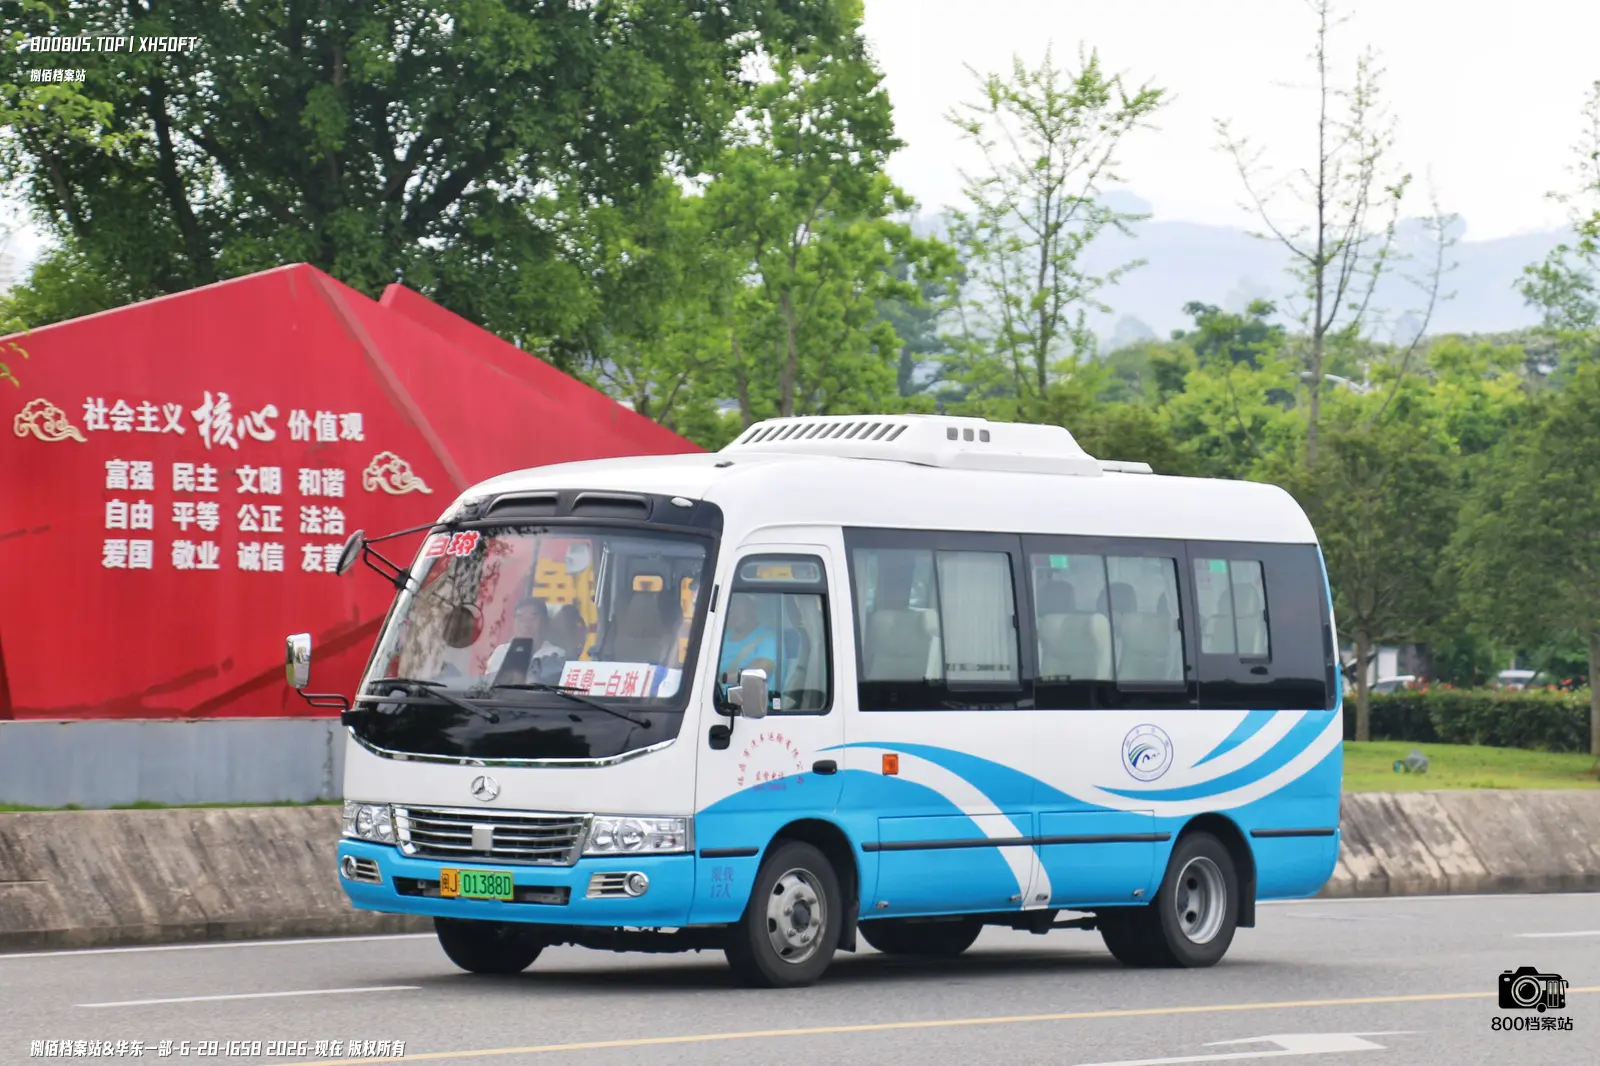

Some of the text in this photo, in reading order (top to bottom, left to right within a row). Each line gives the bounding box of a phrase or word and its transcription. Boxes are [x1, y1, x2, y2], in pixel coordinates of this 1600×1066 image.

[83, 391, 364, 450] 社会主义 核心 价值观
[105, 459, 345, 497] 富强 民主 文明 和谐
[105, 499, 345, 535] 自由 平等 公正 法治
[102, 538, 344, 573] 爱国 敬业 诚信 友善
